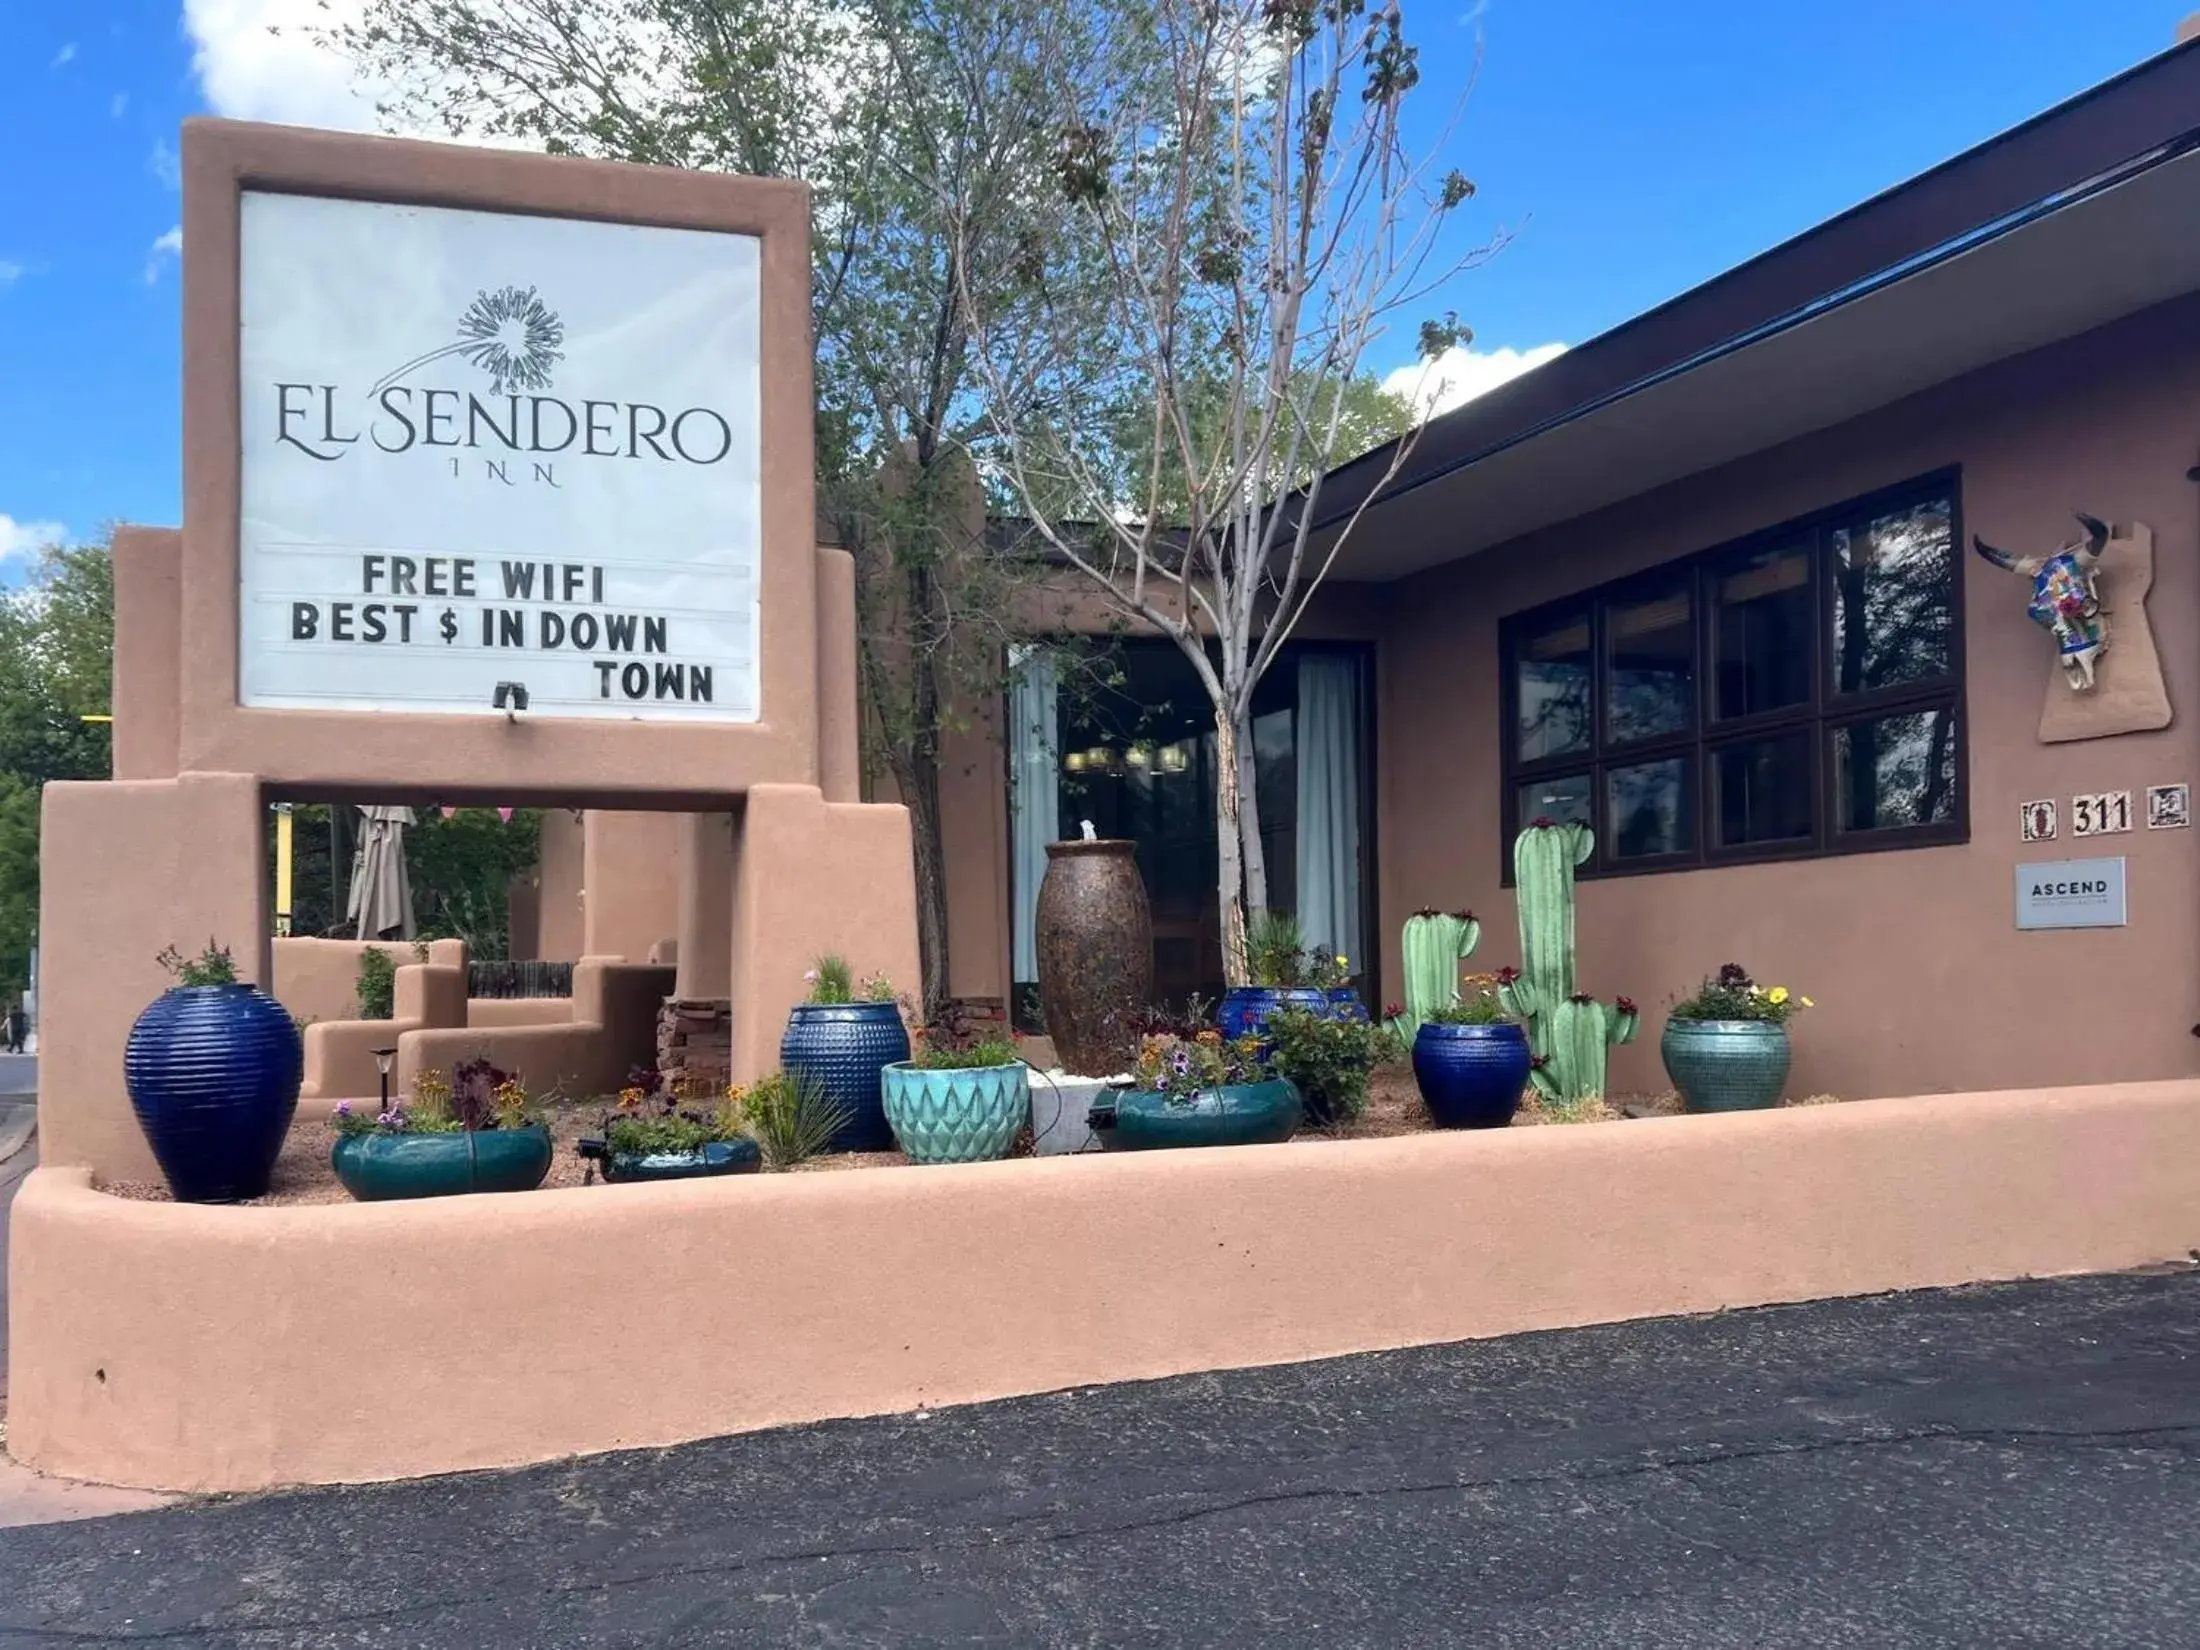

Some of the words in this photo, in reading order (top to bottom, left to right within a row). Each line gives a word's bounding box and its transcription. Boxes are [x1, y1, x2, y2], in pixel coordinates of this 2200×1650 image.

[273, 383, 360, 461] EL
[370, 386, 732, 464] SENDERO
[448, 457, 561, 488] INN
[363, 555, 476, 597] FREE
[501, 560, 604, 602] WIFI
[292, 602, 418, 643] BEST
[439, 607, 458, 645] $
[482, 608, 524, 647] IN
[540, 611, 667, 653] DOWN
[593, 660, 714, 702] TOWN
[2075, 796, 2128, 832] 311
[2032, 880, 2107, 896] ASCEND
